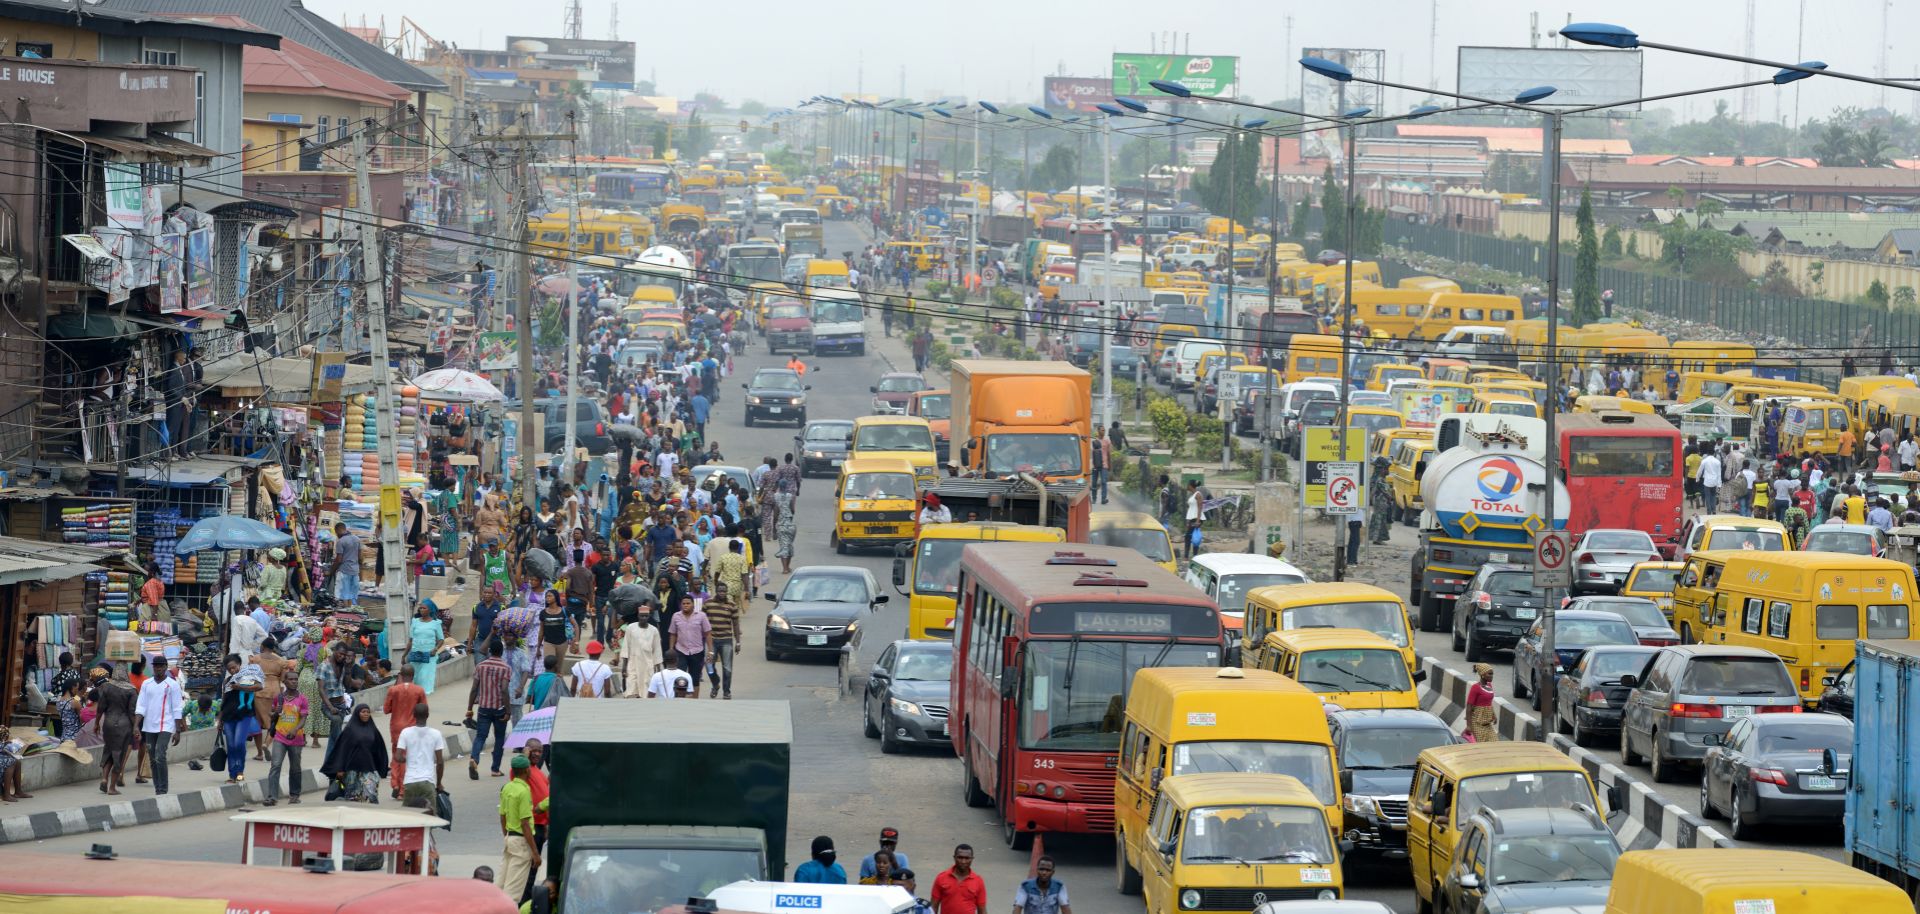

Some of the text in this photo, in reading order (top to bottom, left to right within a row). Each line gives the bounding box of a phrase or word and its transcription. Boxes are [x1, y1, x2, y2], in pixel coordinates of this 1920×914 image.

[1188, 62, 1211, 71] MILO
[0, 68, 55, 85] E HOUSE
[1471, 498, 1525, 514] TOTAL
[1077, 612, 1166, 628] LAG BUS
[1033, 759, 1055, 769] 343
[274, 825, 310, 844] POLICE
[364, 828, 401, 847] POLICE
[778, 896, 819, 907] POLICE
